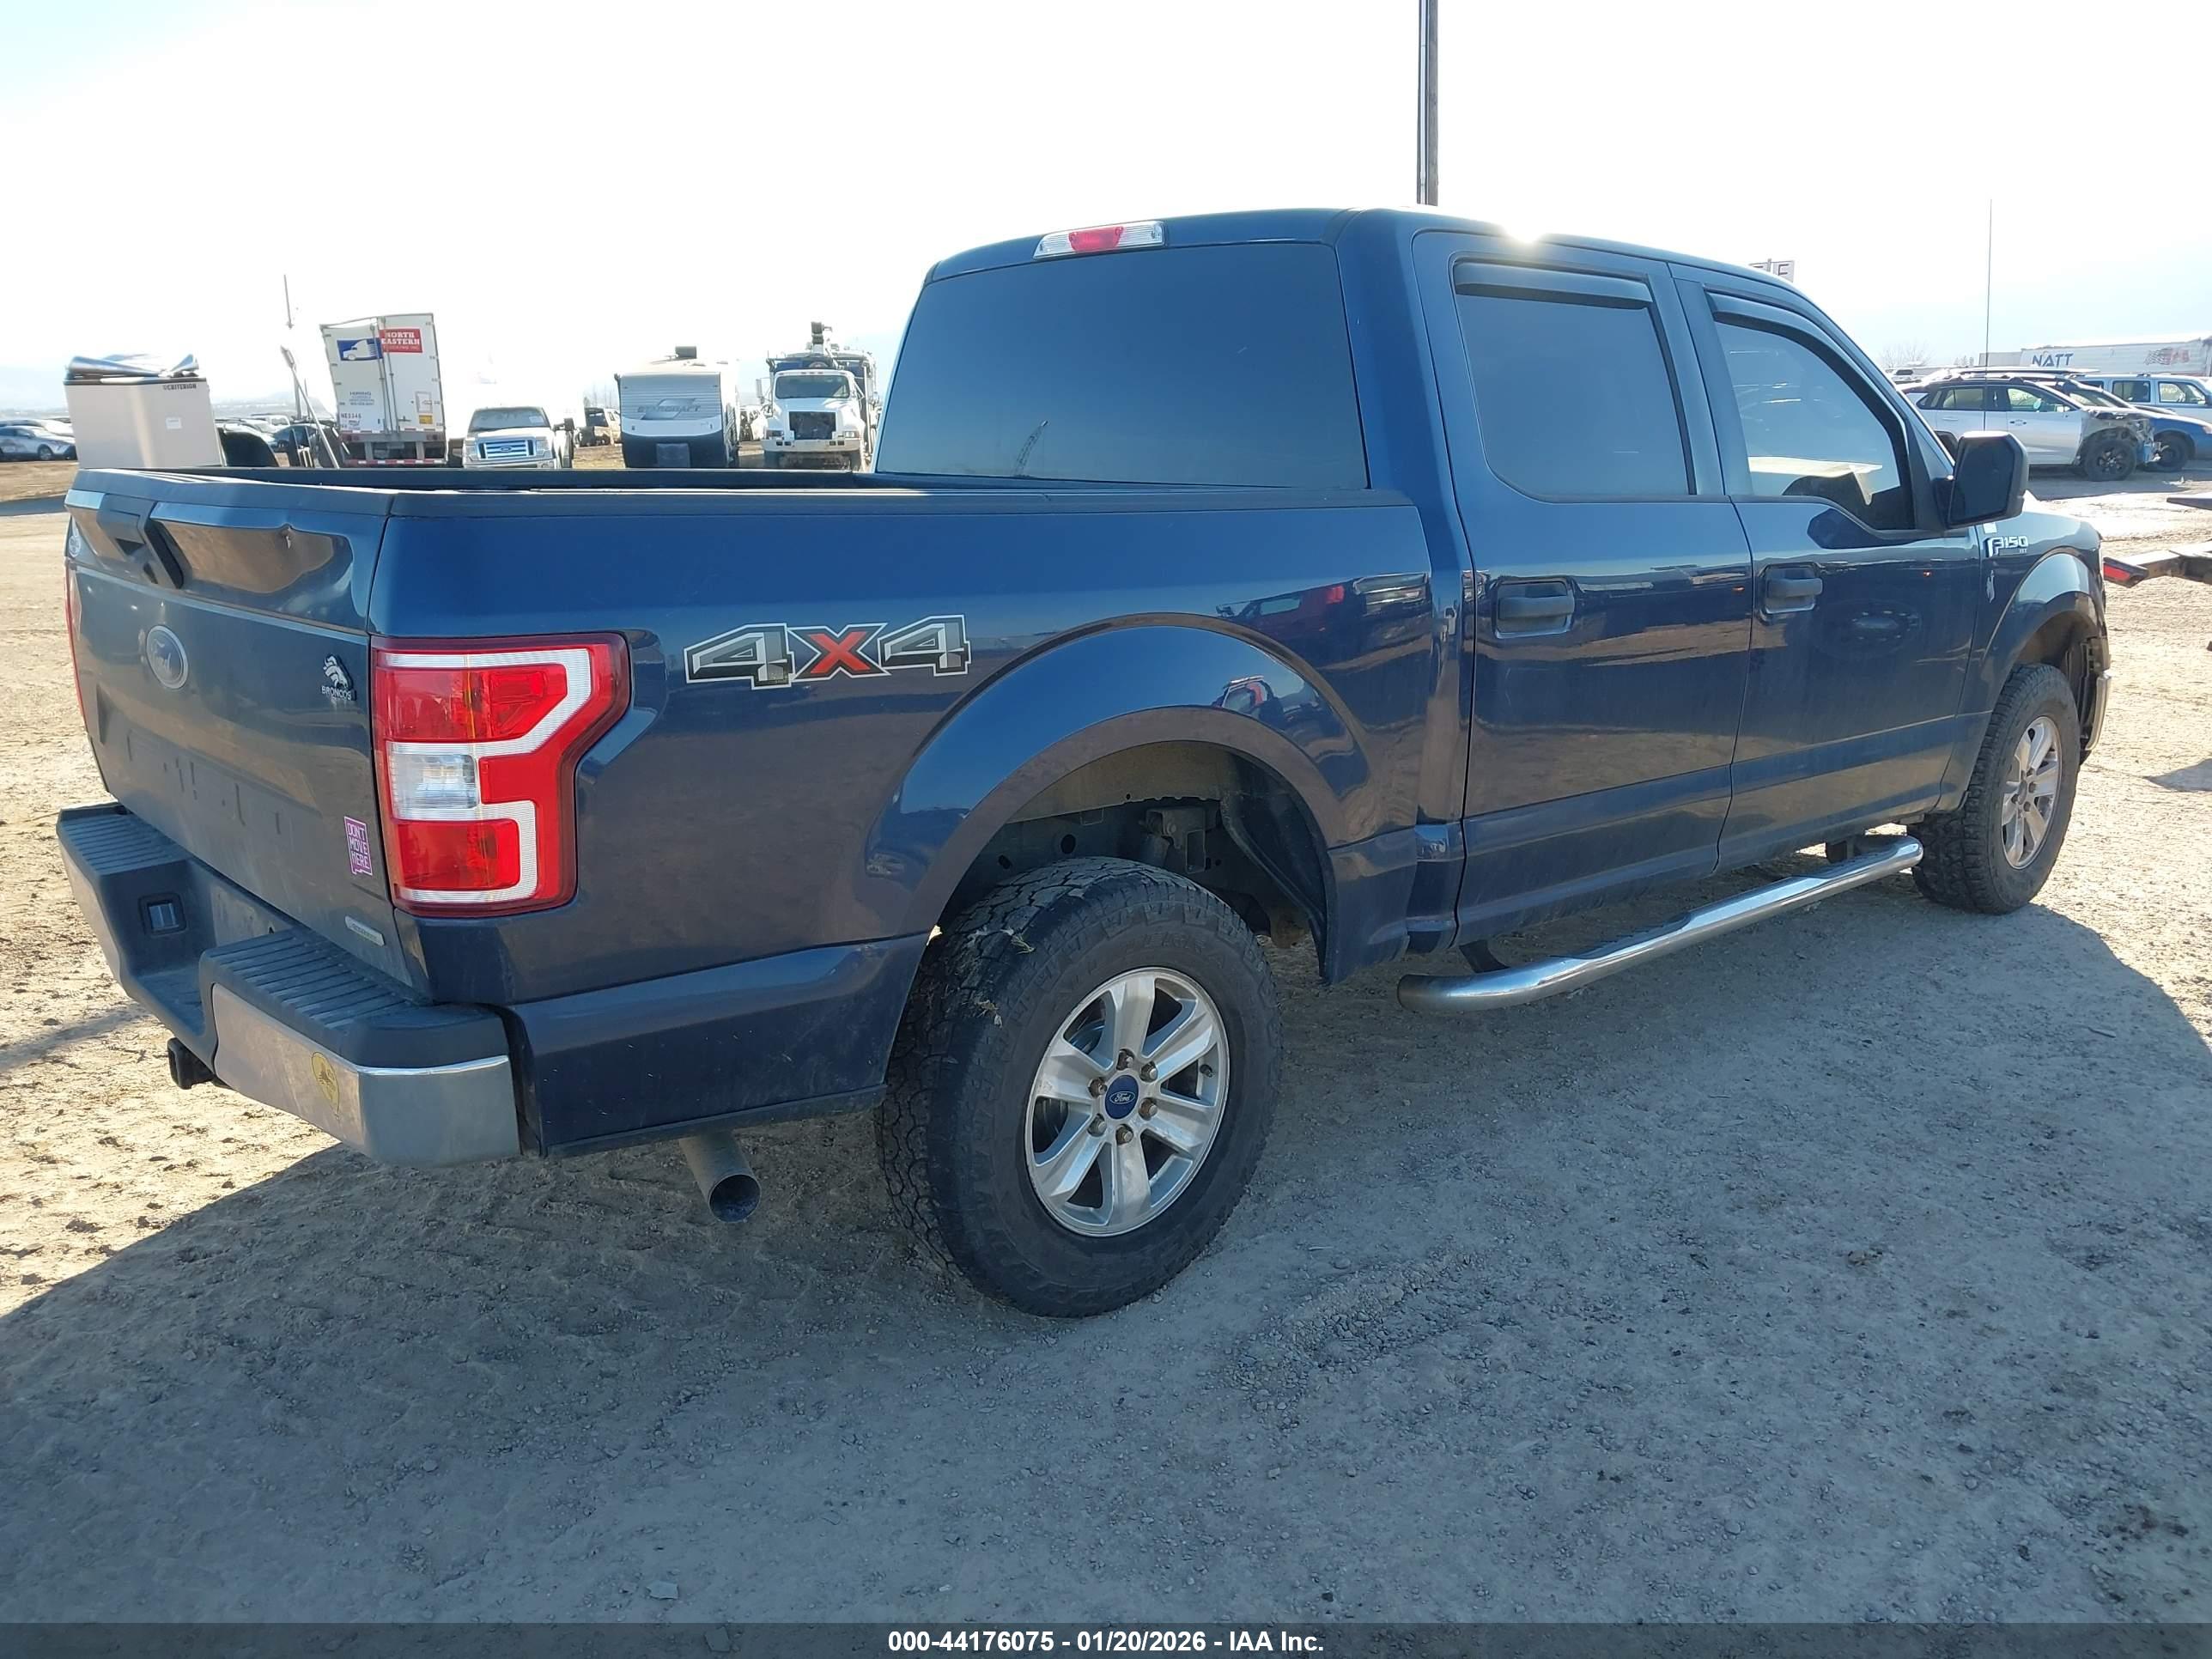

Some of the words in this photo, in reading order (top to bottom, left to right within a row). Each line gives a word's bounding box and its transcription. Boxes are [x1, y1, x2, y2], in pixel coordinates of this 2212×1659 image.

[2032, 353, 2074, 368] NATT
[684, 614, 972, 690] 4X4
[321, 685, 352, 701] BRONCOS
[349, 836, 368, 855] MOVE
[350, 850, 370, 870] HERE
[1113, 1091, 1133, 1103] Ford
